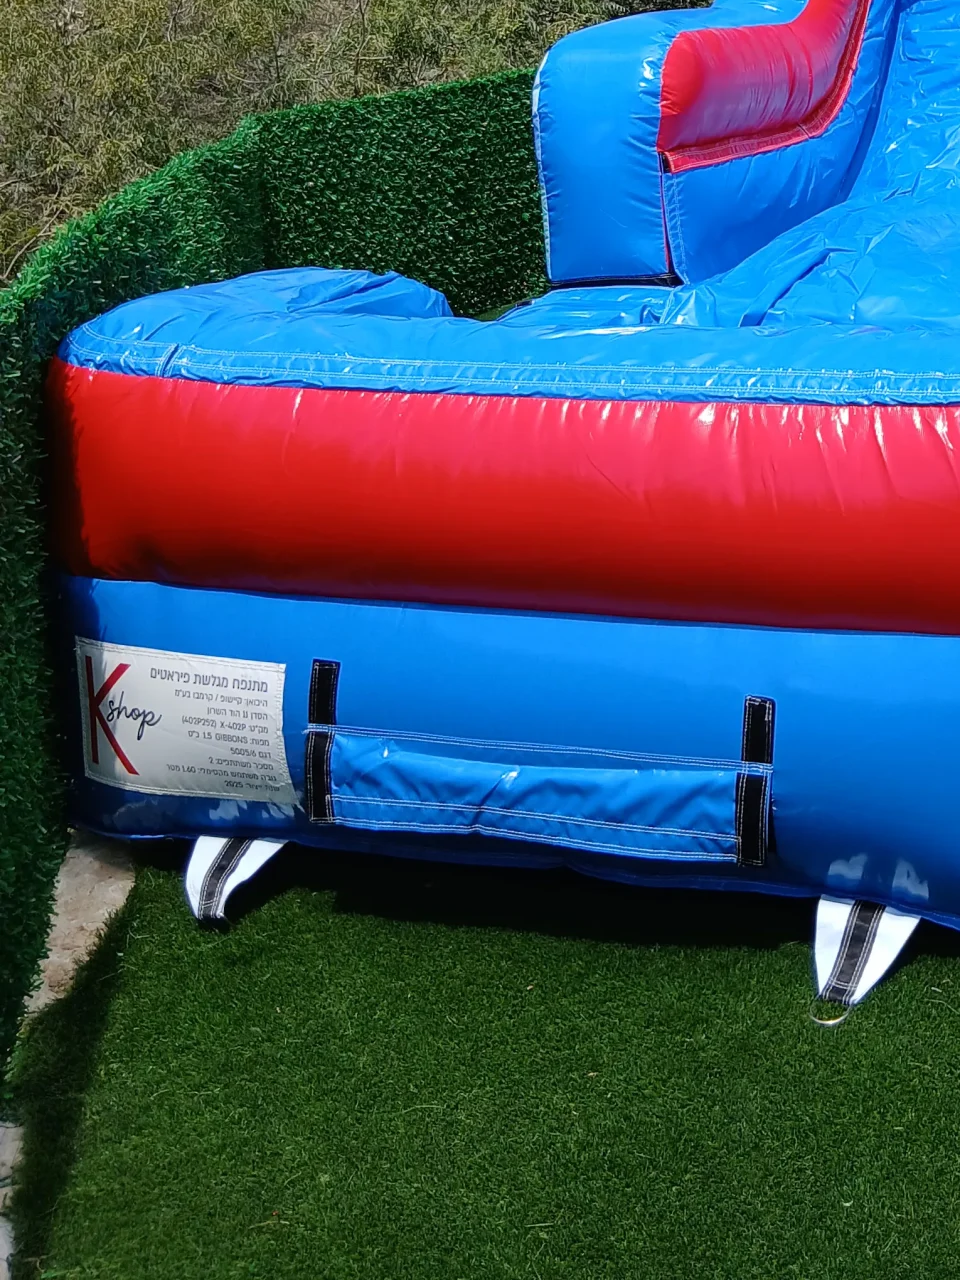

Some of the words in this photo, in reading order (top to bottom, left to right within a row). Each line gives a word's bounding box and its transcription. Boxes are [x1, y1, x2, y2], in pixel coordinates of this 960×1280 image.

[150, 667, 190, 683] פיראטים
[193, 674, 229, 688] מגלשת
[233, 678, 268, 693] מתנפח
[85, 655, 140, 776] K
[106, 691, 162, 740] shop
[207, 706, 227, 716] השרון
[229, 709, 241, 717] הוד
[220, 720, 246, 731] X-402P
[215, 733, 248, 744] GIBBONS
[208, 756, 214, 764] 2
